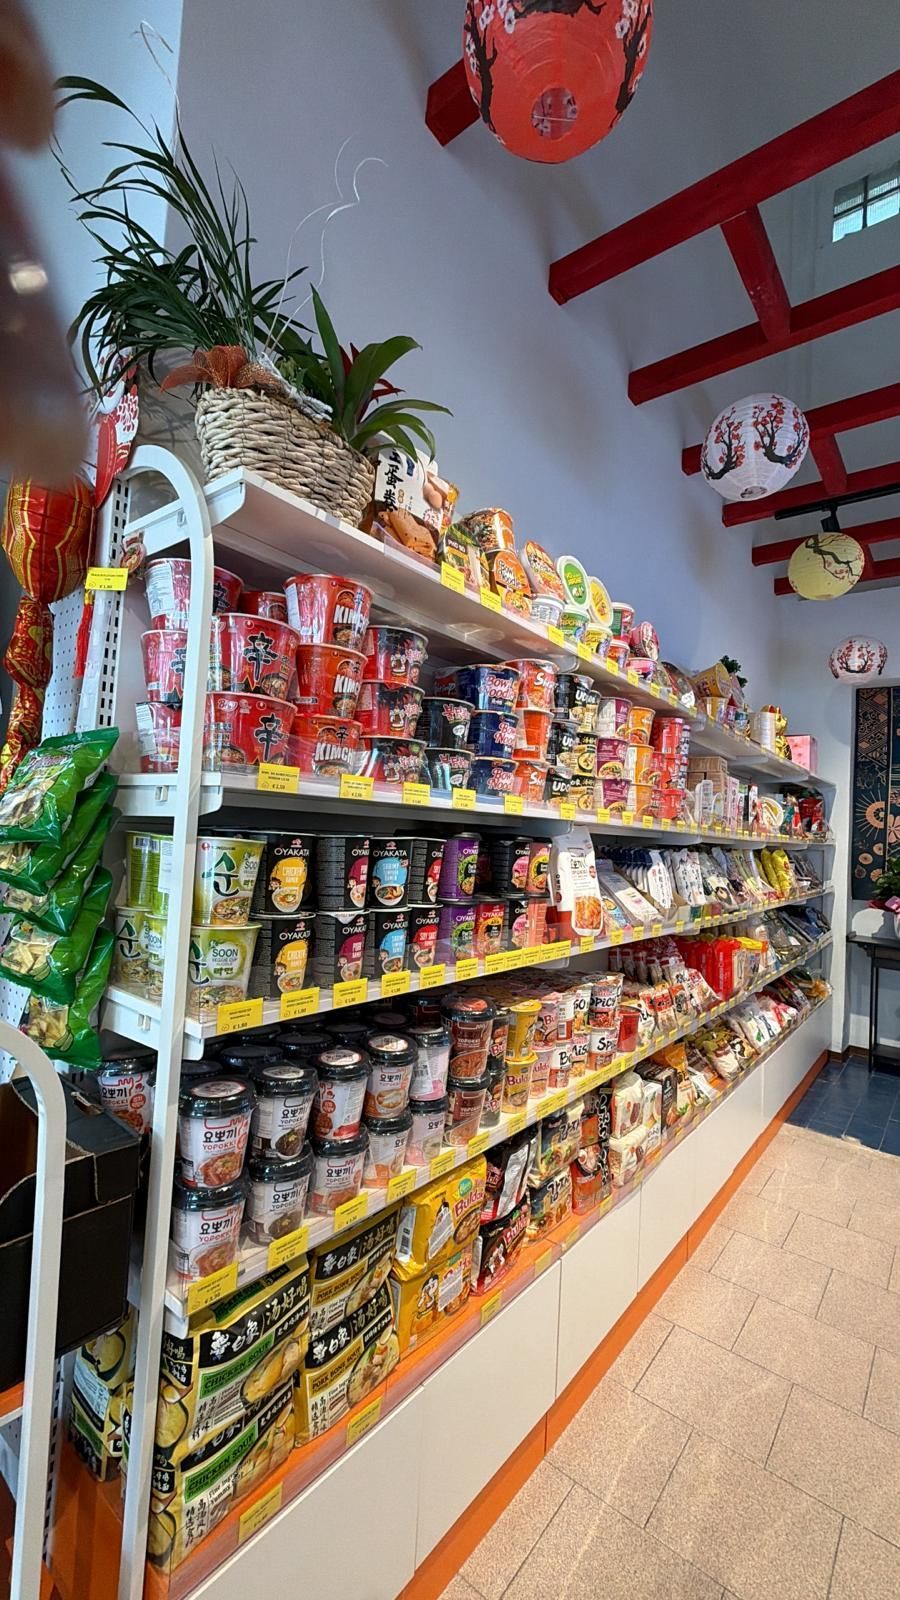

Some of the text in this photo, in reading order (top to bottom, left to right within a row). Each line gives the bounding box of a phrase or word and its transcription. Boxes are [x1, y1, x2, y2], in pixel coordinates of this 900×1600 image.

[242, 631, 278, 682] 辛
[254, 712, 284, 762] 辛
[373, 849, 407, 857] OYAKATA
[212, 948, 238, 957] SOON
[203, 1126, 237, 1143] 요뽀끼
[200, 1217, 233, 1235] 요뽀끼
[188, 1454, 231, 1491] CHICKEN
